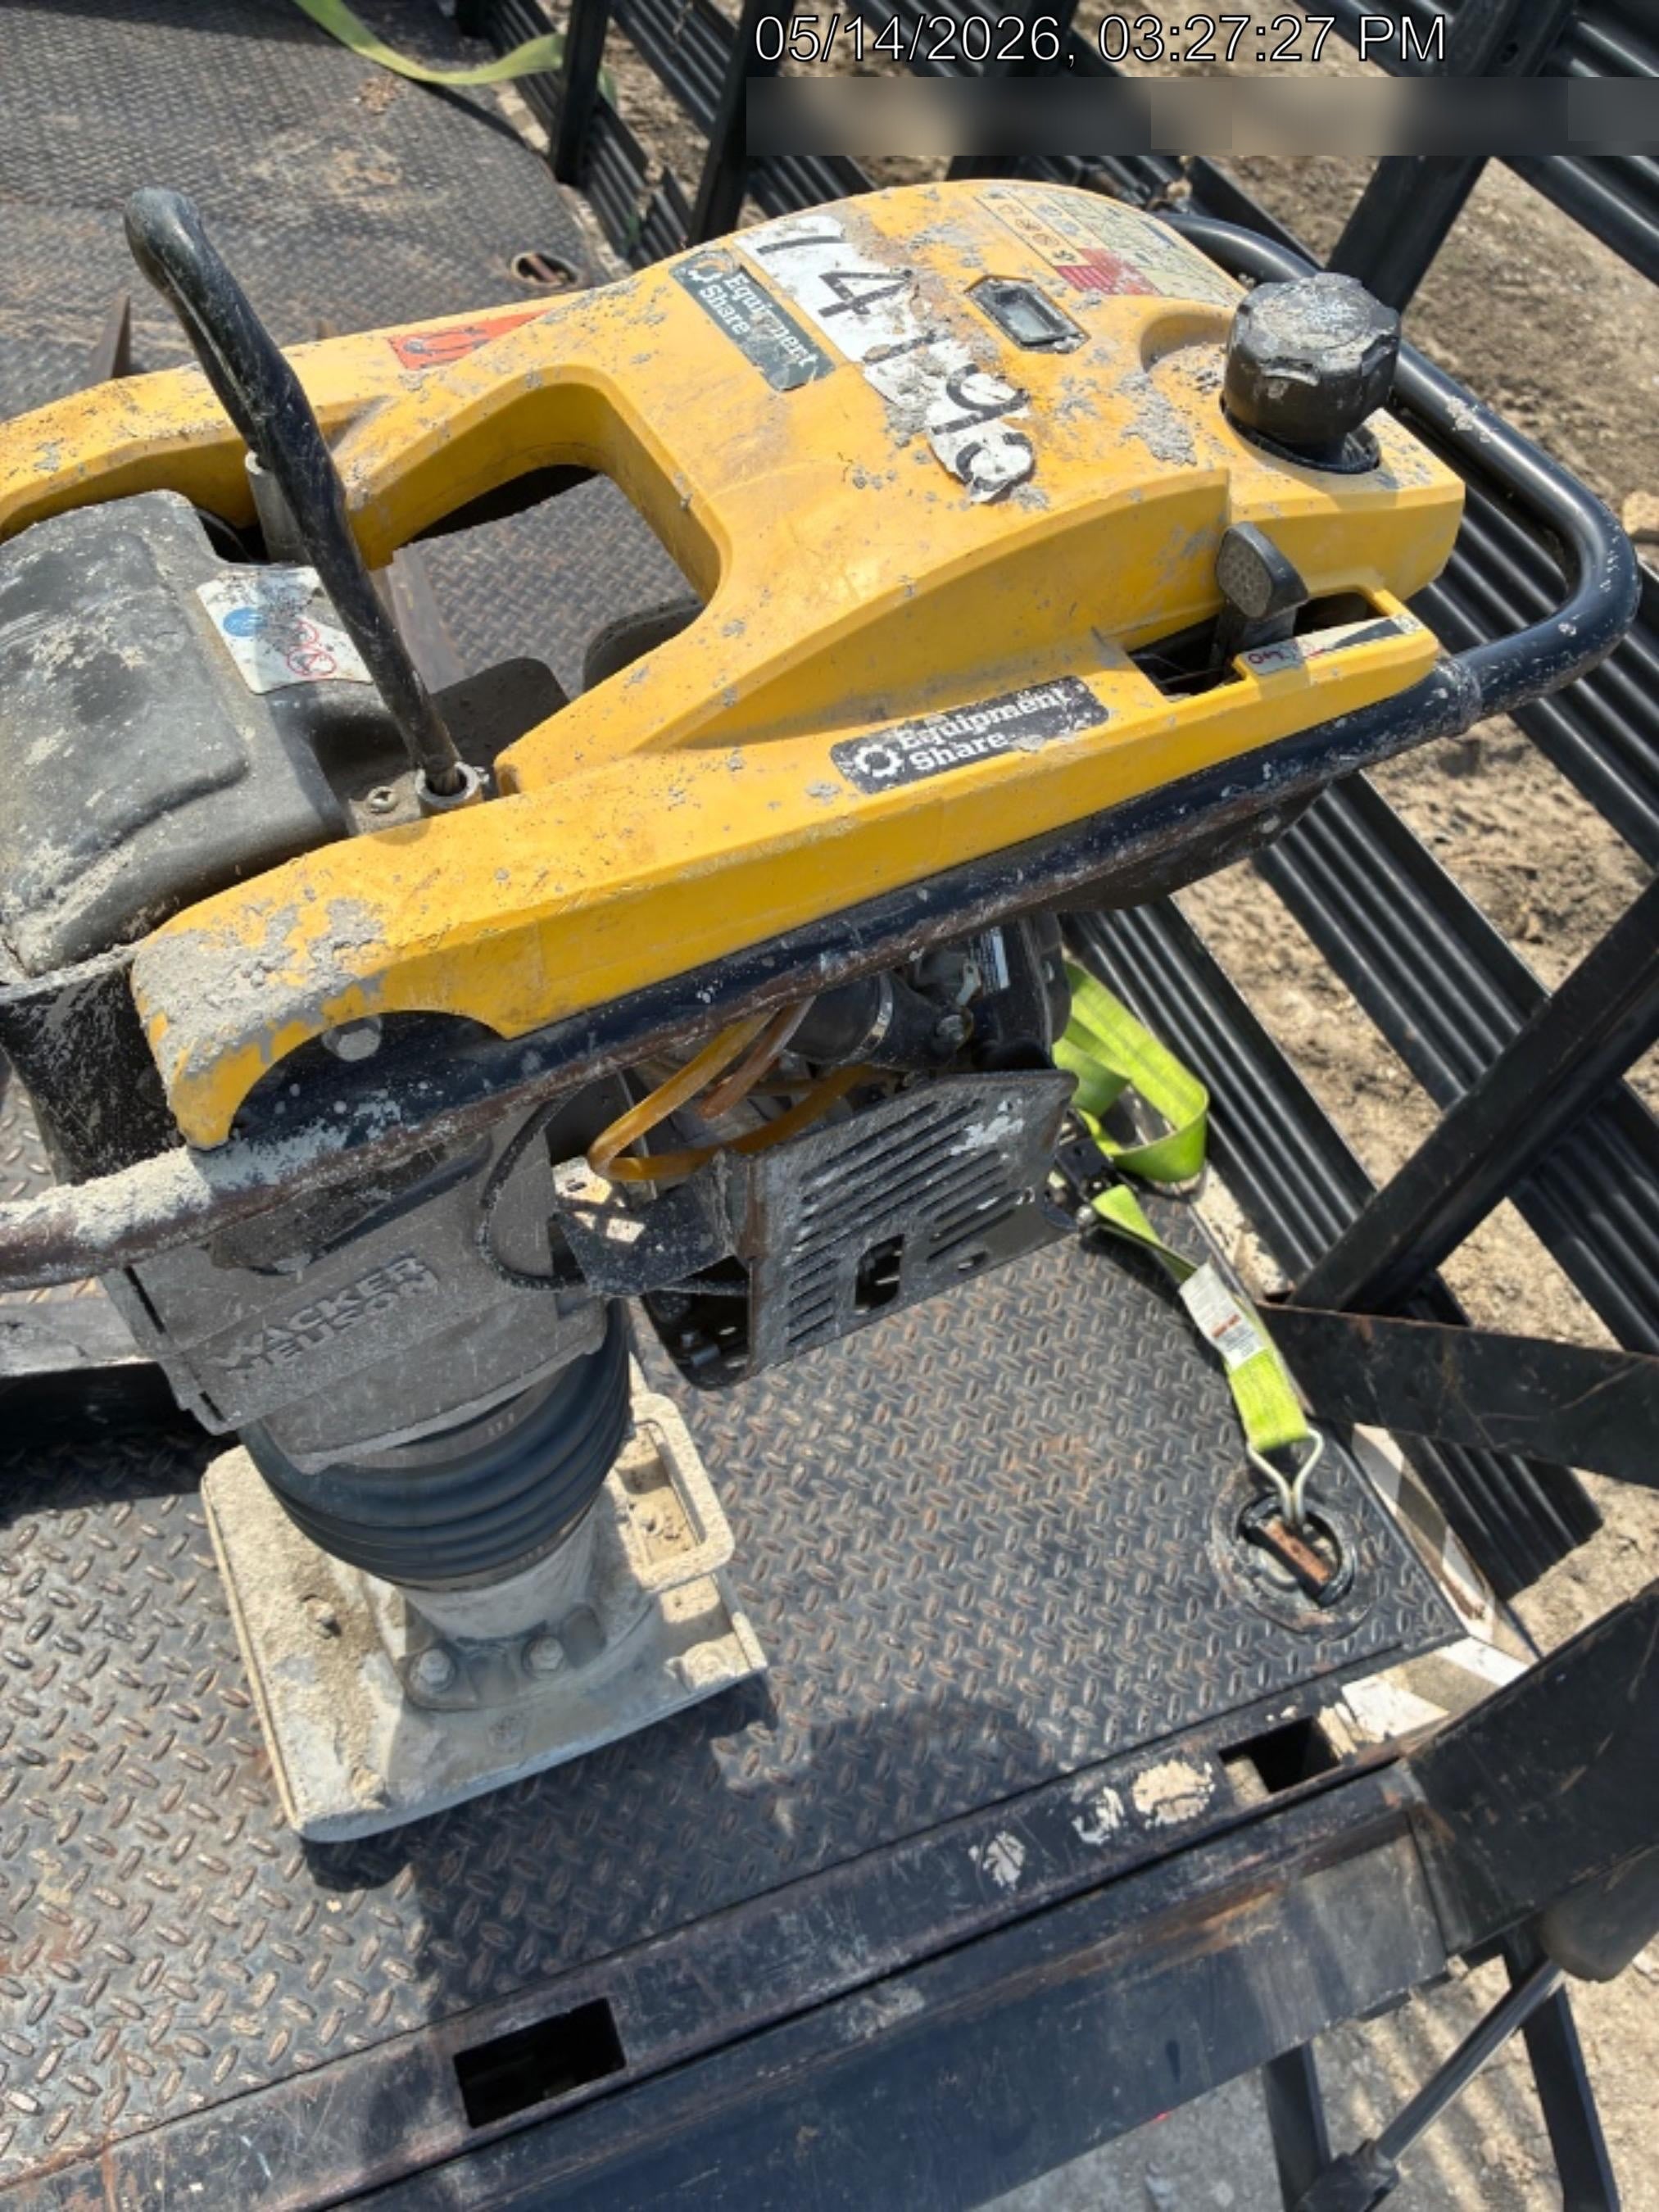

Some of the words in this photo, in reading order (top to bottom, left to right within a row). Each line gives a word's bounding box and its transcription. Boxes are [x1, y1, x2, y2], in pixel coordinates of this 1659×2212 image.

[699, 284, 750, 335] Share
[723, 273, 818, 367] Equiment
[896, 686, 1072, 751] Equipment
[909, 732, 1010, 773] Share
[207, 1255, 425, 1369] WACKER
